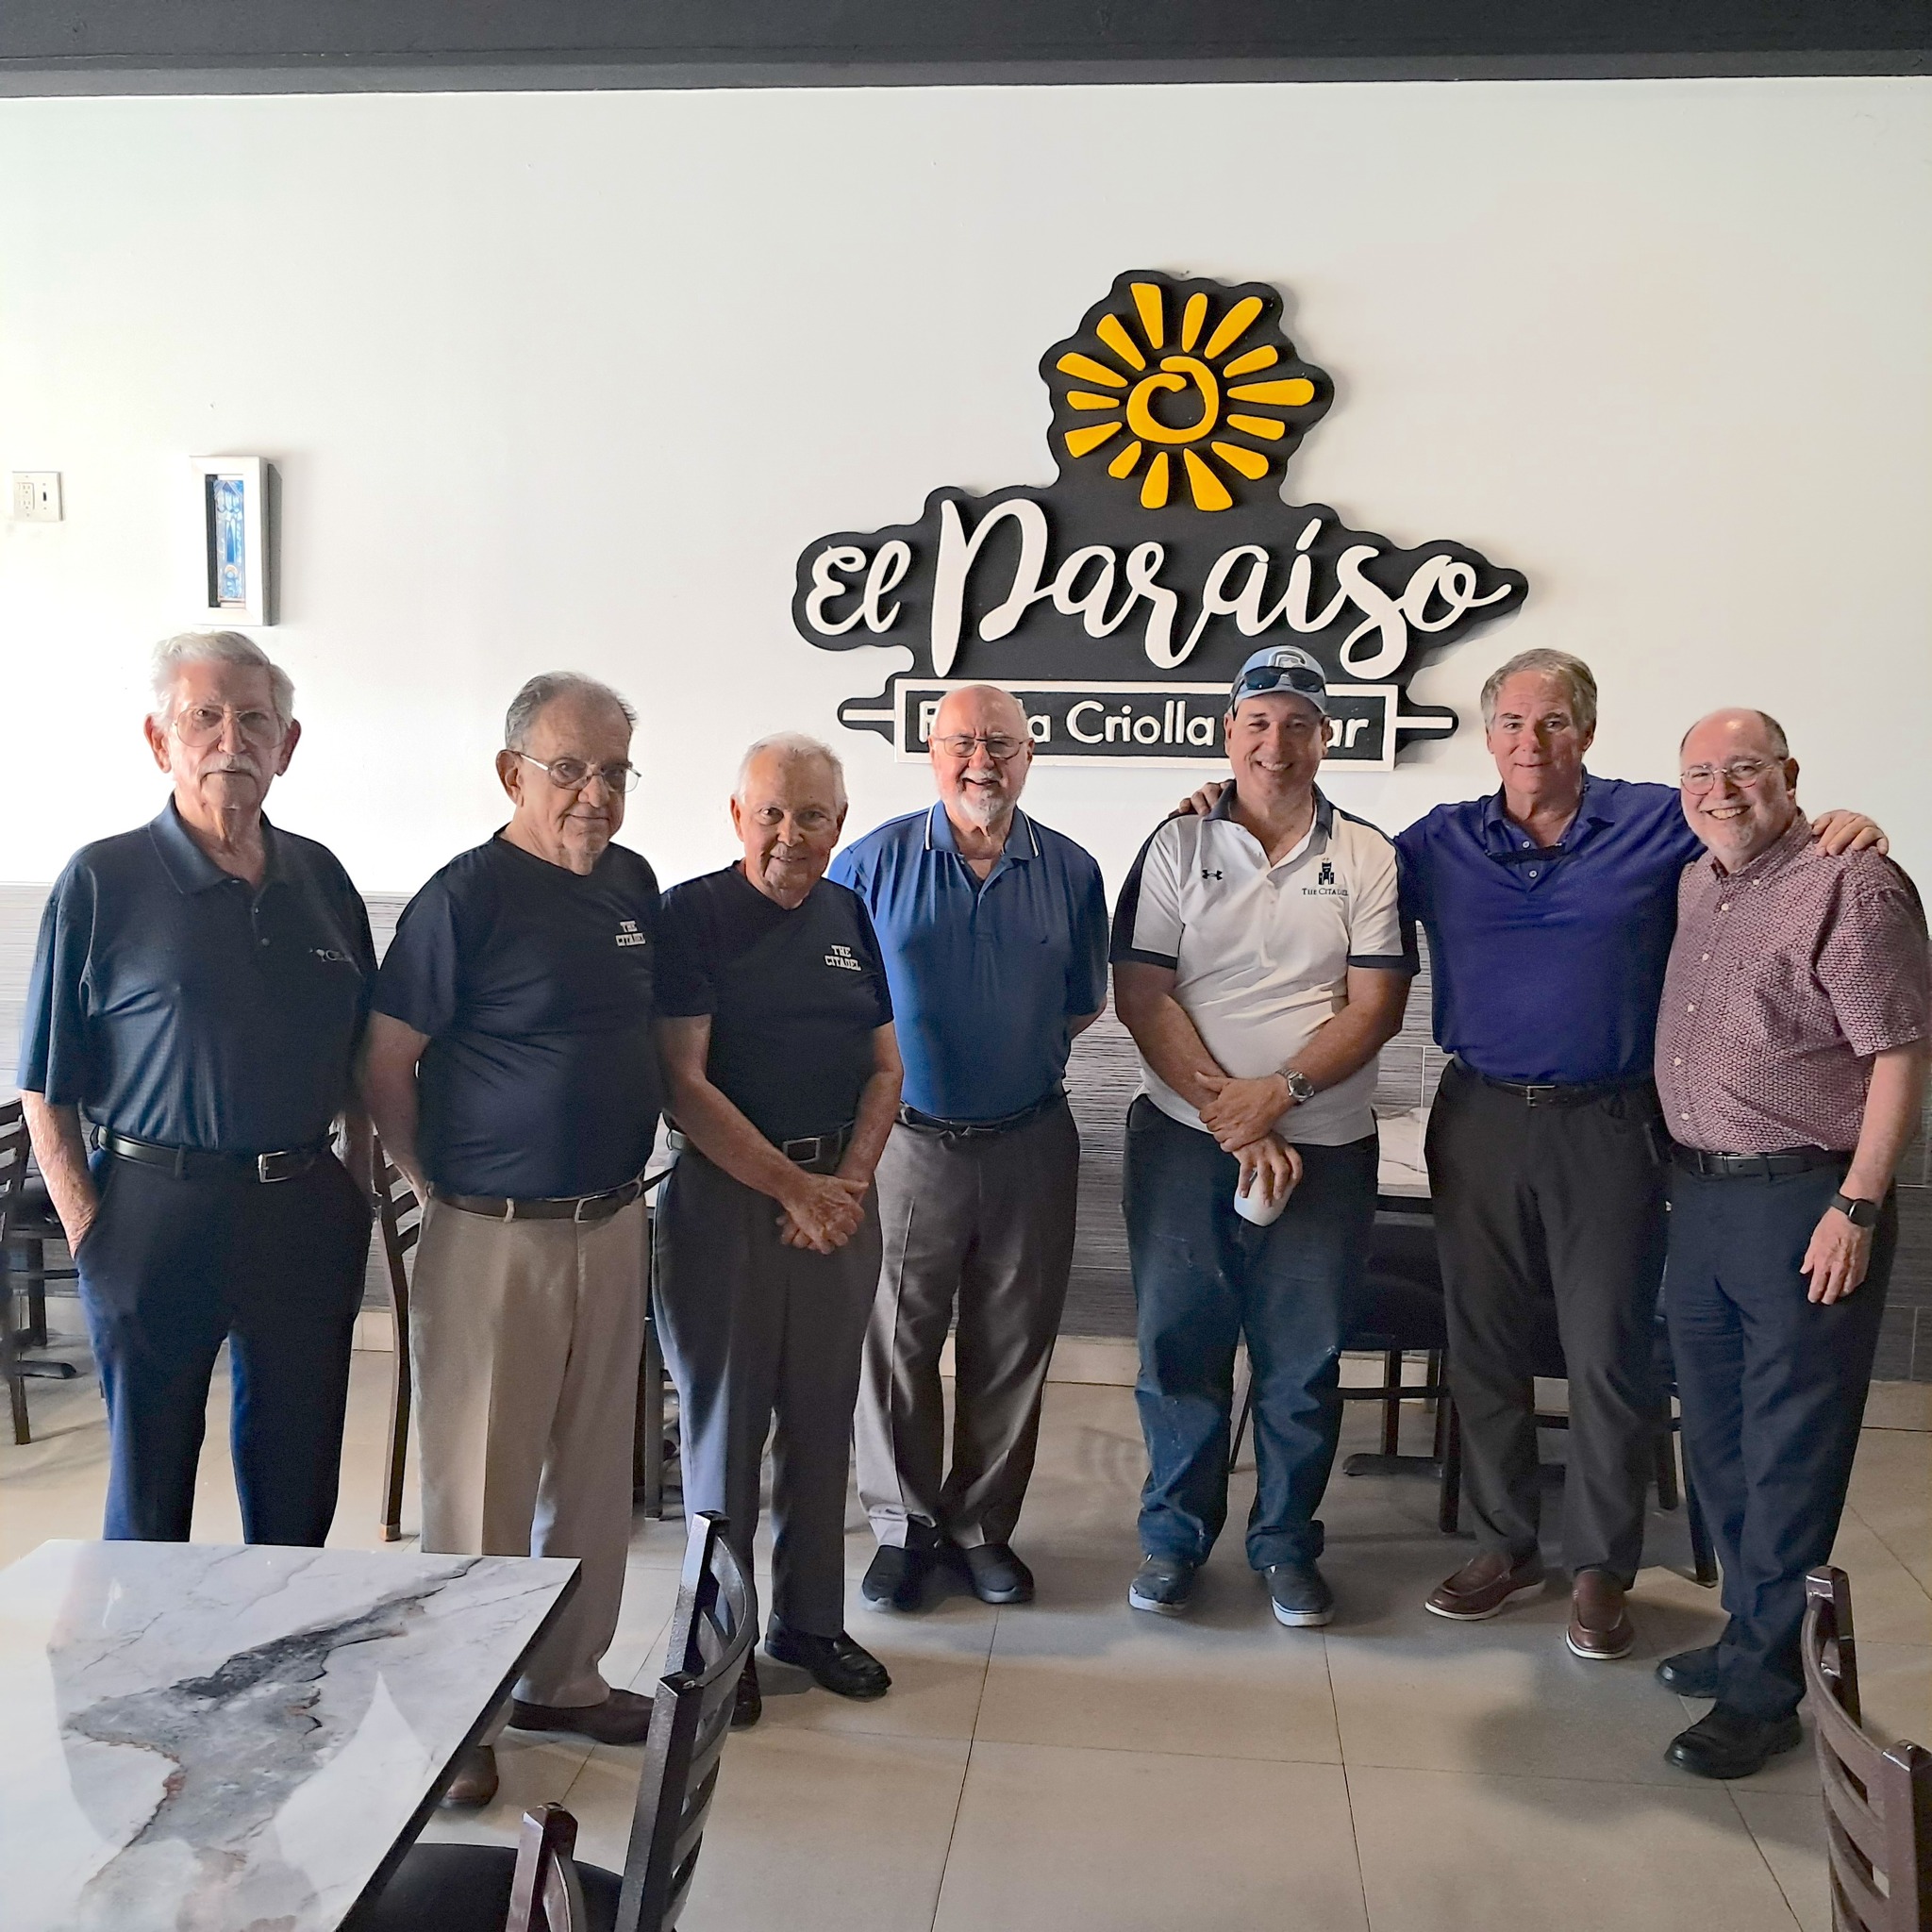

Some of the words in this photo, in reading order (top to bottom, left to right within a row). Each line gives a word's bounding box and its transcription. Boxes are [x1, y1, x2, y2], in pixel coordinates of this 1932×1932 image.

[806, 541, 910, 636] El
[930, 498, 1512, 680] Paraíso
[1066, 699, 1215, 746] Criolla
[824, 955, 862, 971] CITADEL
[830, 944, 852, 958] THE
